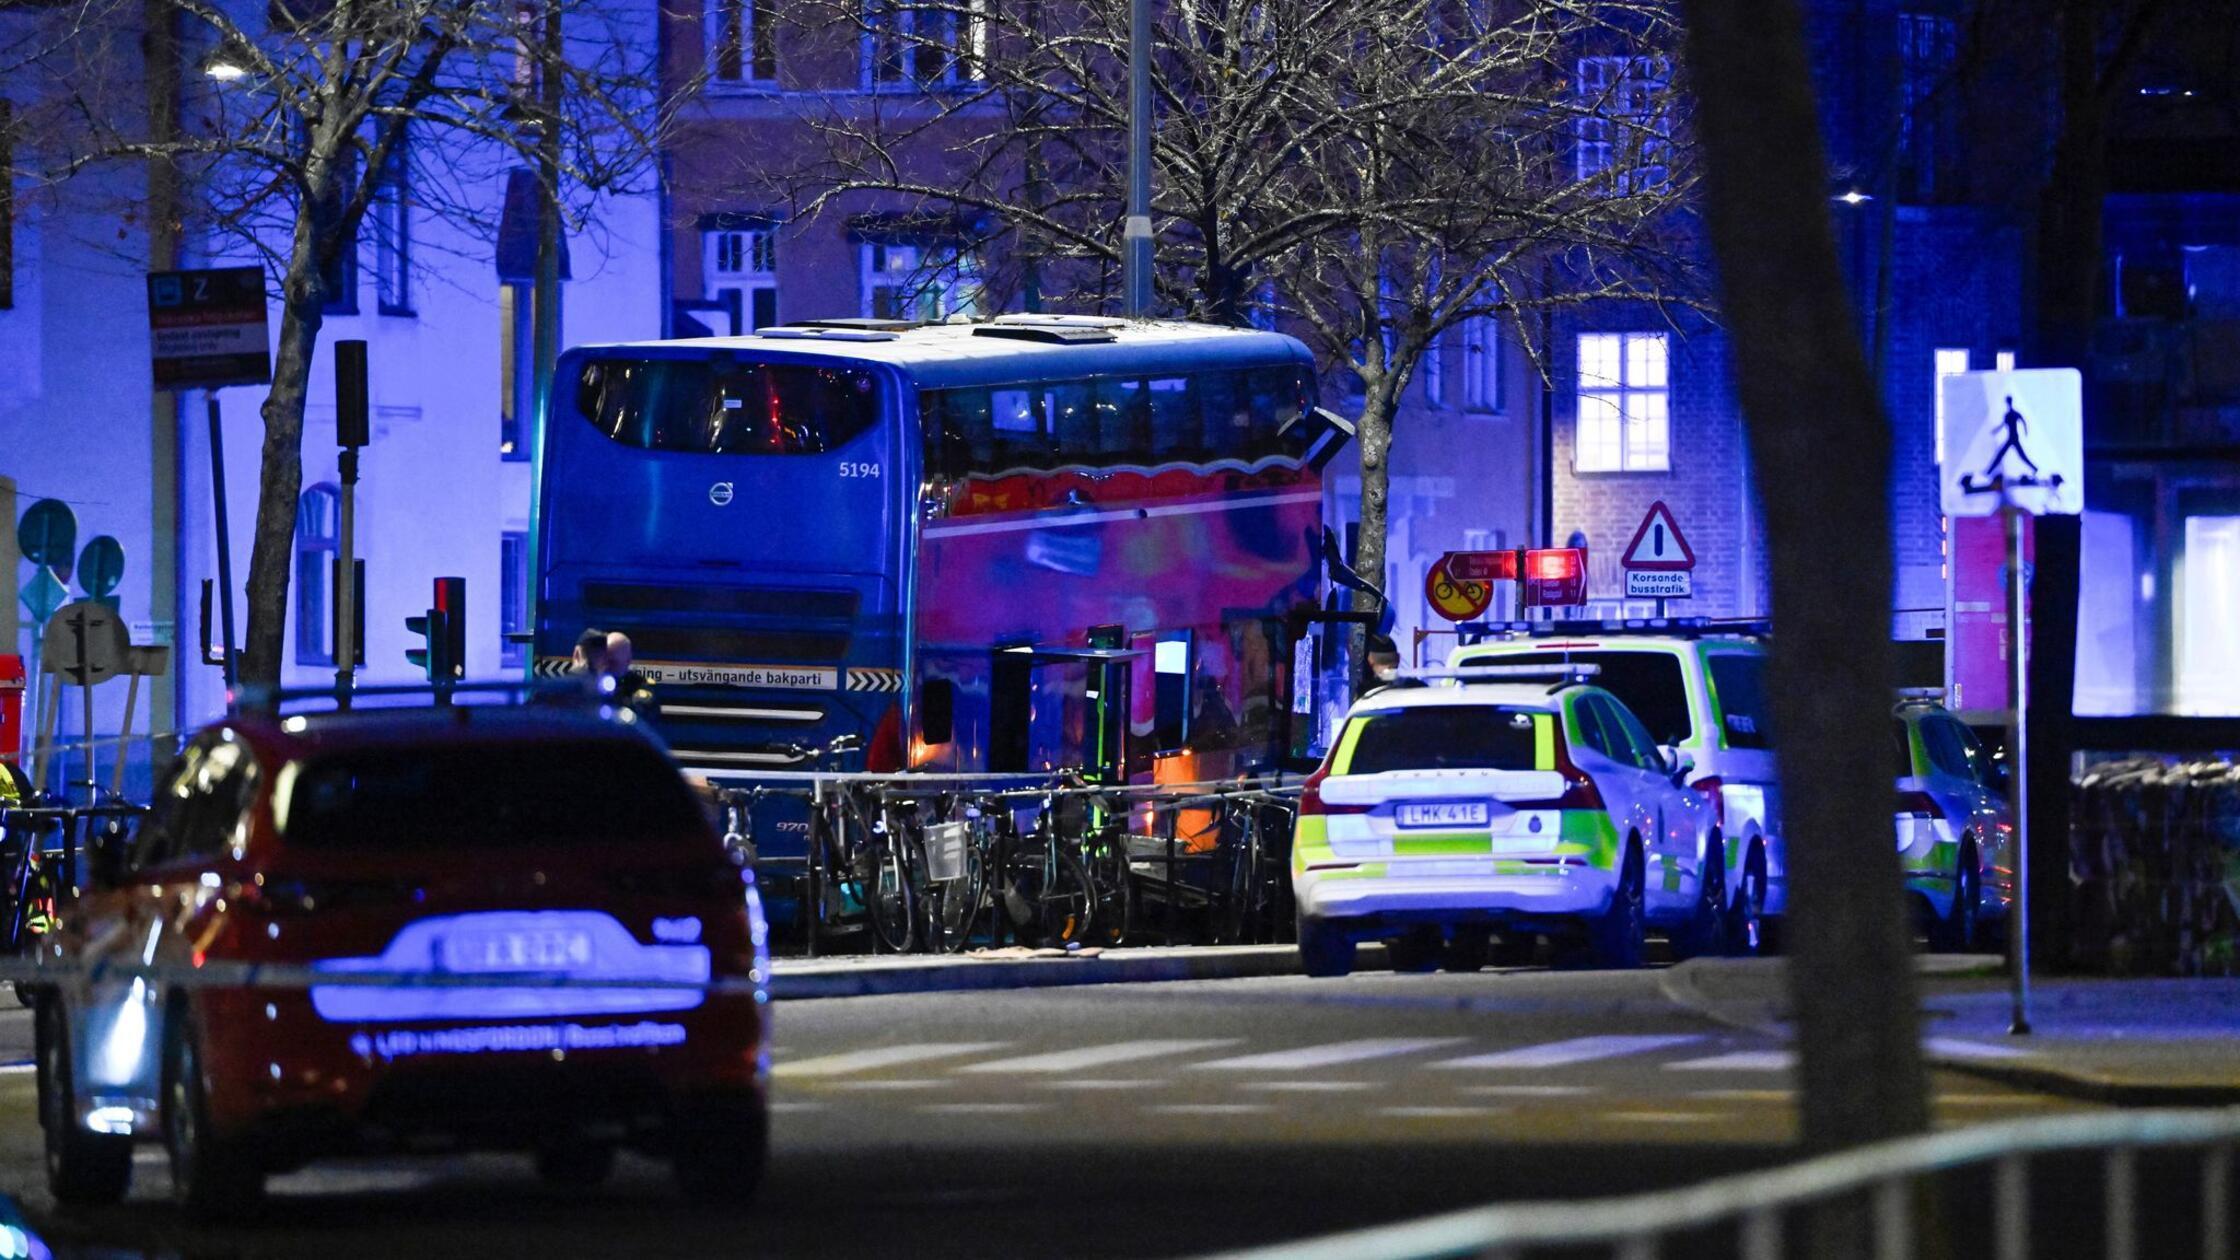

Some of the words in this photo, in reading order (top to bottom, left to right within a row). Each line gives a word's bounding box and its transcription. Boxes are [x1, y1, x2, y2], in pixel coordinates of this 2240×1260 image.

[839, 462, 881, 479] 5194
[1632, 573, 1684, 582] Korsande
[1631, 585, 1685, 593] busstrafik
[679, 669, 762, 685] utsvängande
[766, 671, 821, 687] bakparti
